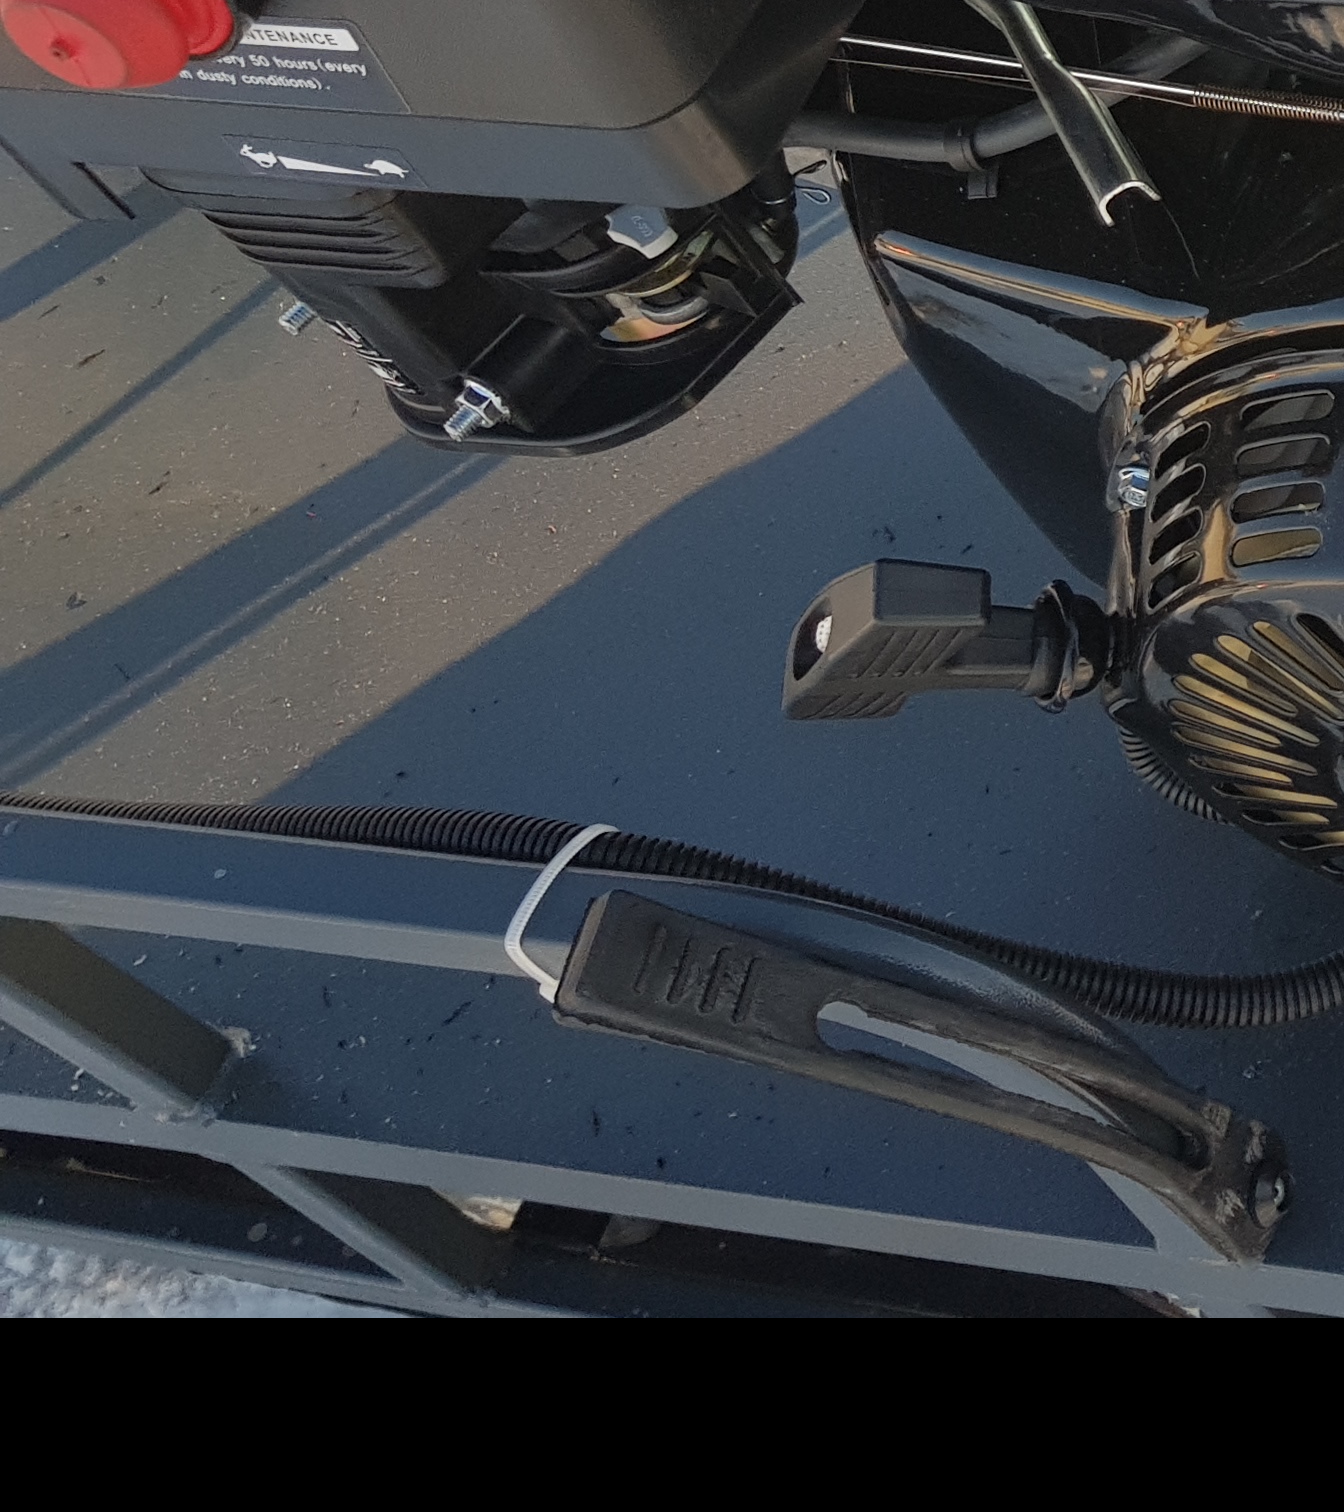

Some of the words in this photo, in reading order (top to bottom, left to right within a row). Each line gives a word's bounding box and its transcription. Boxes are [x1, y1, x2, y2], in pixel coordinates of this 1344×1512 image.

[245, 29, 338, 46] NTENANCE
[250, 55, 270, 68] 50
[197, 70, 237, 86] dusty
